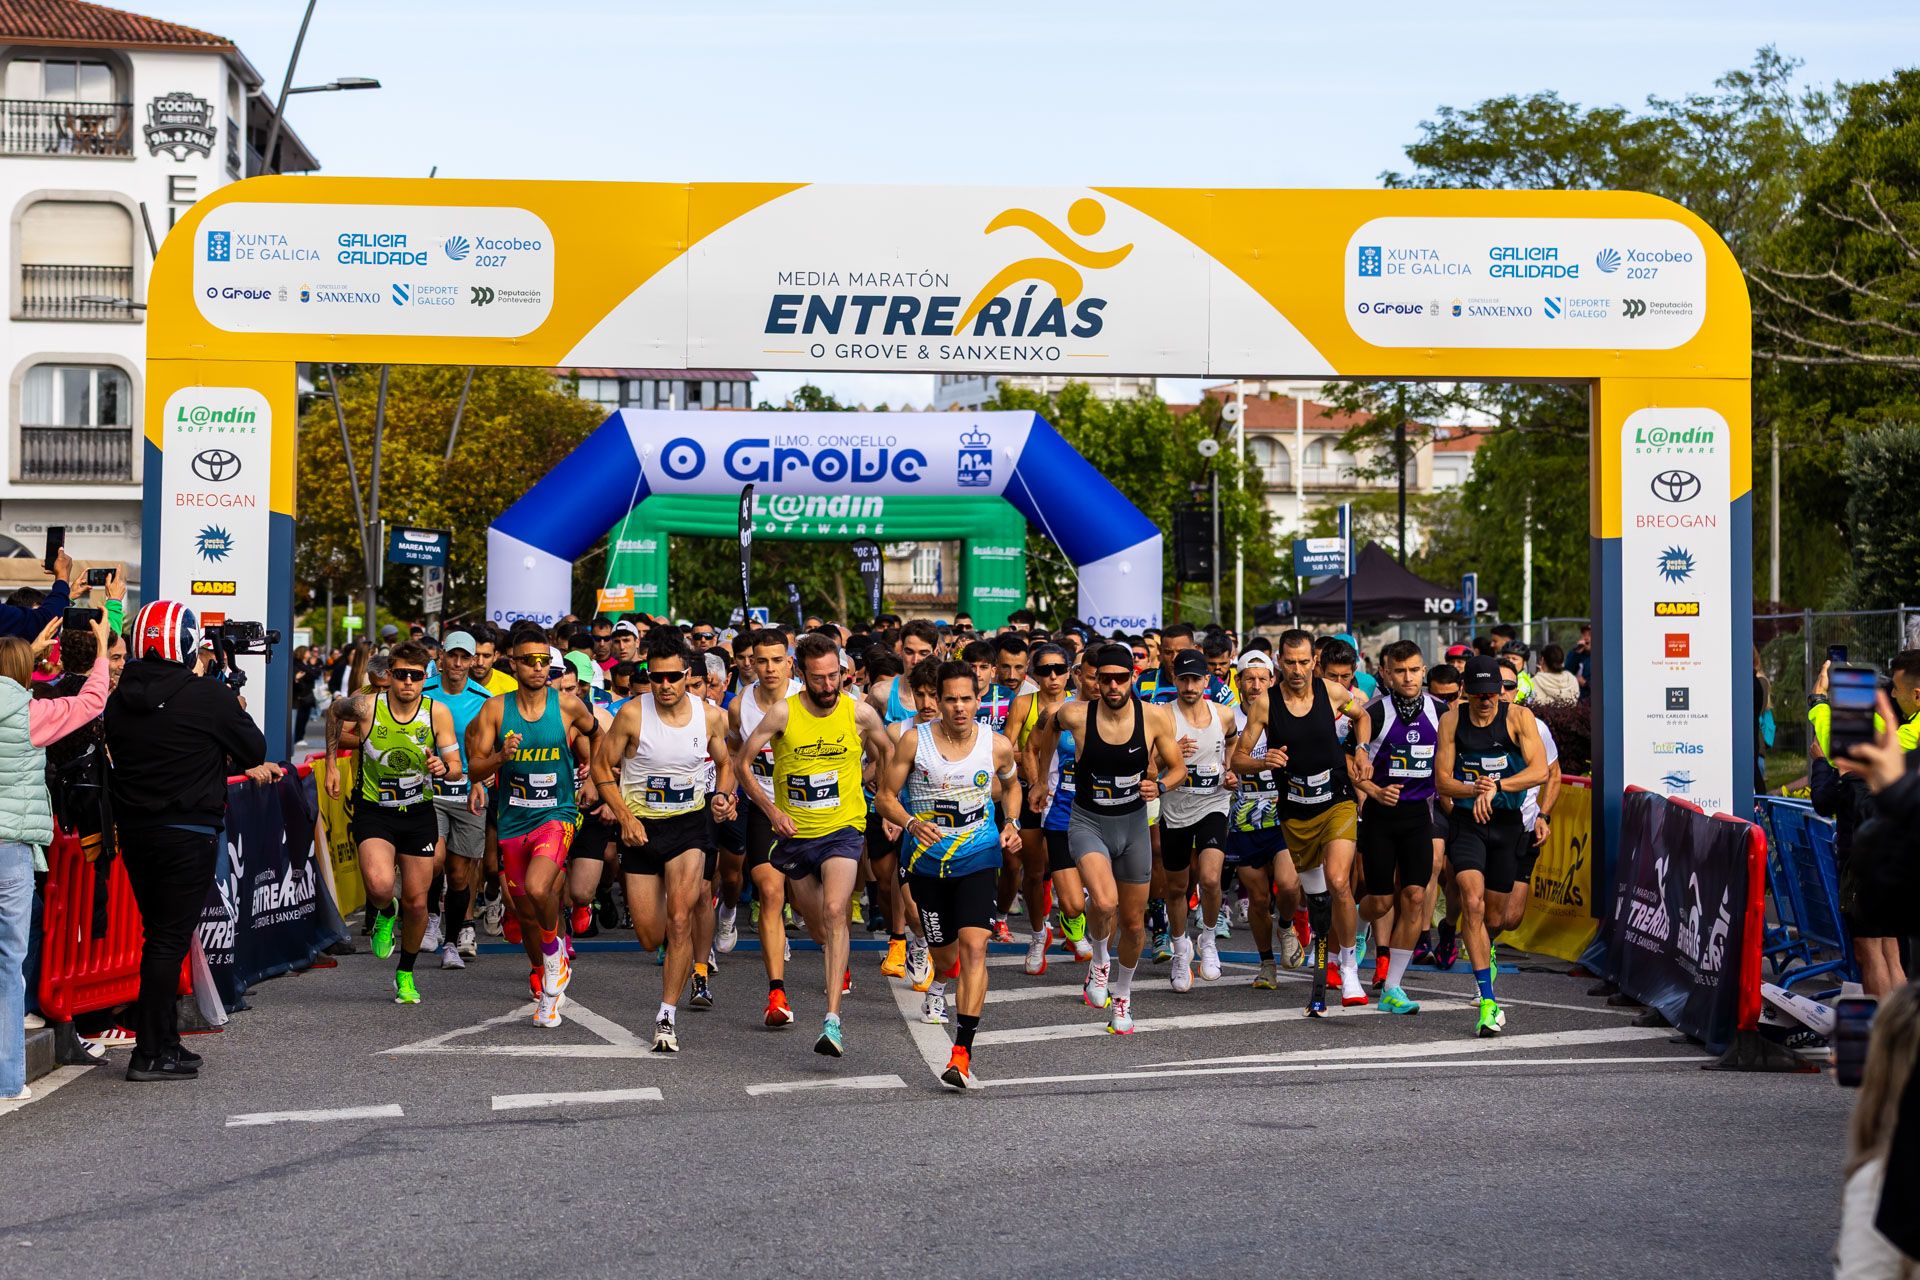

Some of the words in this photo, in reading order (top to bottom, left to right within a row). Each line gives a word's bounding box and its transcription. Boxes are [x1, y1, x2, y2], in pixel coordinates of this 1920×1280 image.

[157, 101, 204, 112] COCINA
[160, 114, 201, 123] ABIERTA
[174, 131, 183, 141] a
[236, 234, 288, 246] XUNTA
[337, 233, 407, 247] GALICIA
[475, 236, 542, 251] Xacobeo
[236, 248, 254, 260] DE
[260, 249, 320, 261] GALICIA
[337, 251, 427, 266] CALIDADE
[1387, 248, 1440, 261] XUNTA
[1489, 247, 1558, 261] GALICIA
[1627, 248, 1693, 262] Xacobeo
[475, 255, 506, 267] 2027
[1387, 263, 1405, 275] DE
[1411, 263, 1472, 275] GALICIA
[1489, 264, 1579, 279] CALIDADE
[1627, 267, 1658, 280] 2027
[778, 271, 840, 287] MEDIA
[848, 269, 949, 288] MARATÓN
[207, 287, 218, 298] O
[222, 287, 272, 299] Grove
[417, 286, 458, 294] DEPORTE
[498, 288, 541, 297] Deputación
[316, 292, 381, 303] SANXENXO
[417, 297, 455, 306] GALEGO
[498, 296, 541, 304] Pontevedra
[1569, 298, 1610, 308] DEPORTE
[1358, 302, 1370, 314] O
[1374, 302, 1423, 314] Grove
[1649, 300, 1693, 308] Deputación
[1468, 305, 1532, 317] SANXENXO
[1569, 309, 1607, 319] GALEGO
[810, 344, 825, 359] O
[835, 344, 907, 359] GROVE
[917, 345, 930, 360] &
[939, 345, 1060, 361] SANXENXO
[177, 405, 256, 425] L@ndín
[774, 435, 813, 447] ILMO.
[817, 435, 896, 447] CONCELLO
[1635, 427, 1714, 447] L@ndín
[660, 437, 706, 481] O
[723, 438, 928, 483] Grove
[176, 493, 256, 507] BREOGAN
[1636, 515, 1716, 528] BREOGAN
[15, 524, 42, 533] Cocina
[75, 524, 85, 533] de
[87, 524, 93, 533] 9
[102, 524, 112, 533] 24
[750, 522, 884, 535] SOFTWARE
[398, 543, 424, 551] MAREA
[424, 545, 441, 553] VIVA
[1303, 554, 1329, 563] MAREA
[193, 581, 235, 594] GADIS
[1656, 602, 1698, 615] GADIS
[980, 714, 1006, 725] RÍAS
[1414, 760, 1427, 768] 46
[1200, 778, 1213, 786] 37
[404, 788, 416, 797] 50
[535, 789, 549, 798] 70
[679, 792, 685, 800] 1
[816, 788, 830, 798] 57
[1315, 787, 1322, 795] 2
[965, 812, 976, 823] 41
[1318, 942, 1327, 969] ÖSSUR
